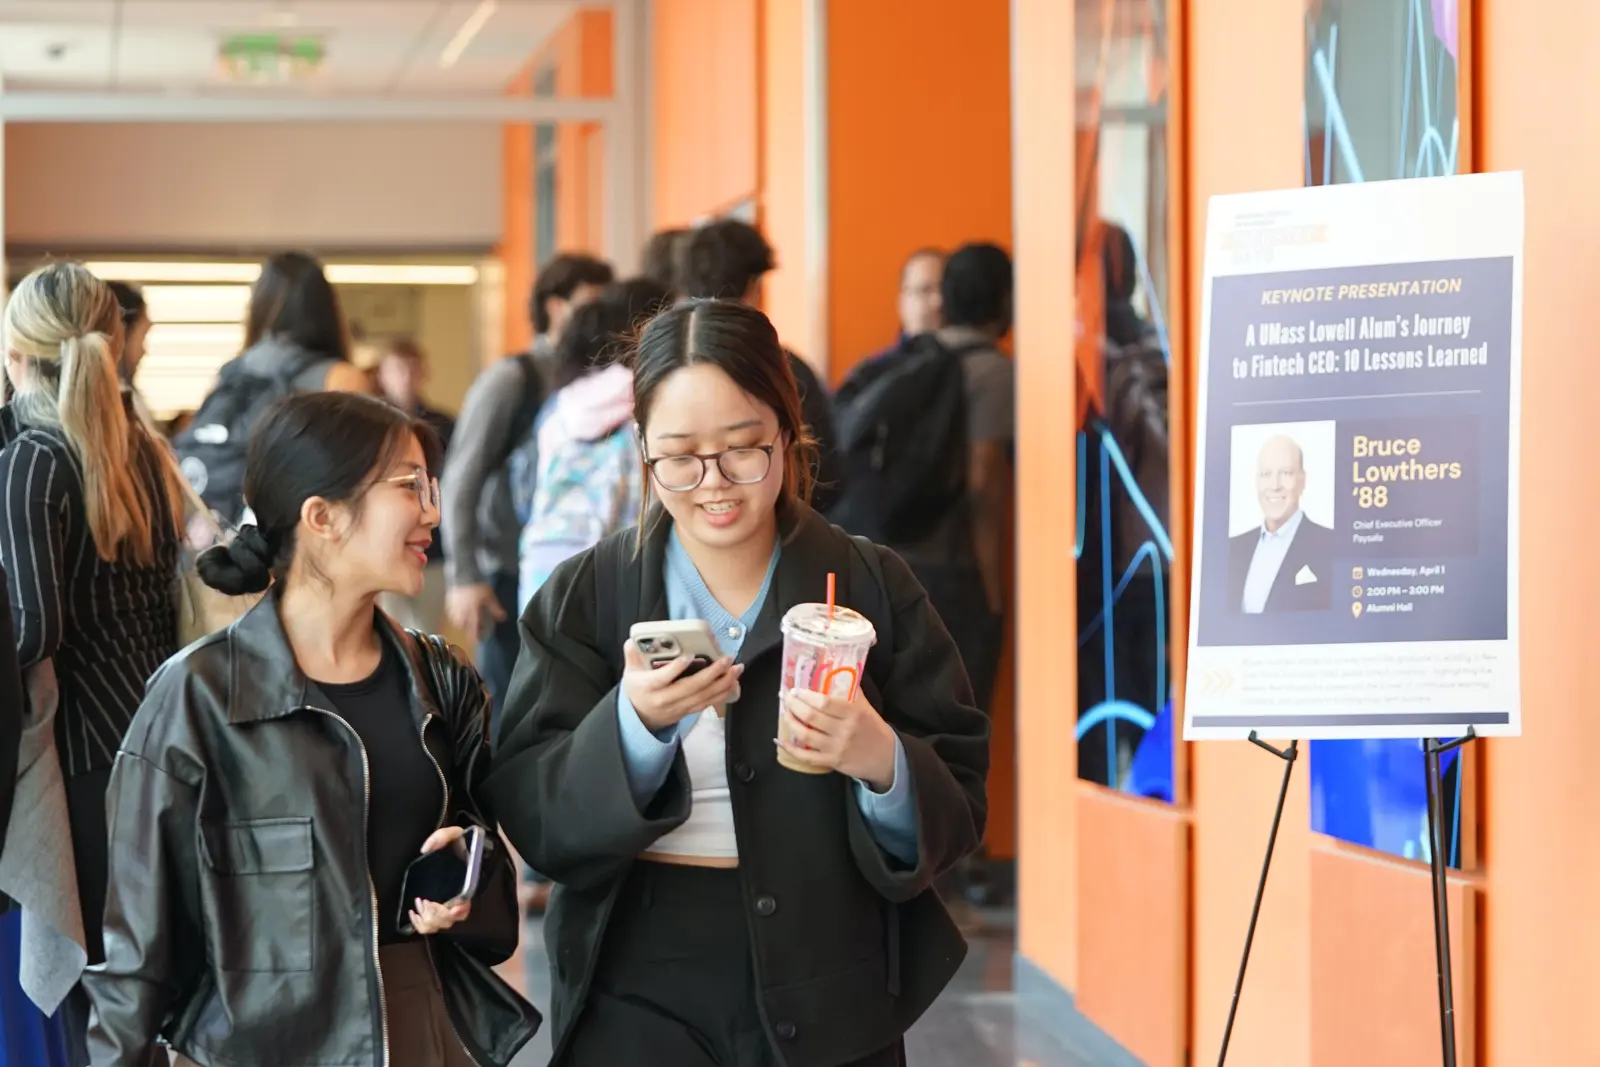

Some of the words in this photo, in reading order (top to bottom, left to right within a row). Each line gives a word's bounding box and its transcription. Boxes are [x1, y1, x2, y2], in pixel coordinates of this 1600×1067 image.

[1261, 286, 1334, 306] KEYNOTE
[1338, 278, 1463, 300] PRESENTATION
[1245, 324, 1256, 347] A
[1259, 321, 1305, 346] UMass
[1309, 317, 1356, 341] Lowell
[1359, 315, 1410, 339] Alum's
[1413, 312, 1472, 338] Journey
[1232, 356, 1248, 379] to
[1251, 352, 1304, 378] Fintech
[1308, 350, 1340, 374] CEO:
[1344, 349, 1360, 371] 10
[1364, 346, 1424, 371] Lessons
[1428, 342, 1488, 367] Learned
[1353, 435, 1421, 458] Bruce
[1353, 458, 1462, 483] Lowthers
[1353, 520, 1374, 530] Chief
[1375, 518, 1413, 529] Executive
[1414, 517, 1443, 527] Officer
[1367, 566, 1418, 577] Wednesday,
[1419, 565, 1440, 576] April
[1441, 565, 1446, 574] 1
[1366, 586, 1386, 596] 2:00
[1387, 586, 1401, 596] PM
[1409, 585, 1429, 595] 3:00
[1430, 585, 1445, 594] PM
[1366, 602, 1395, 613] Alumni
[1396, 602, 1413, 612] Hall
